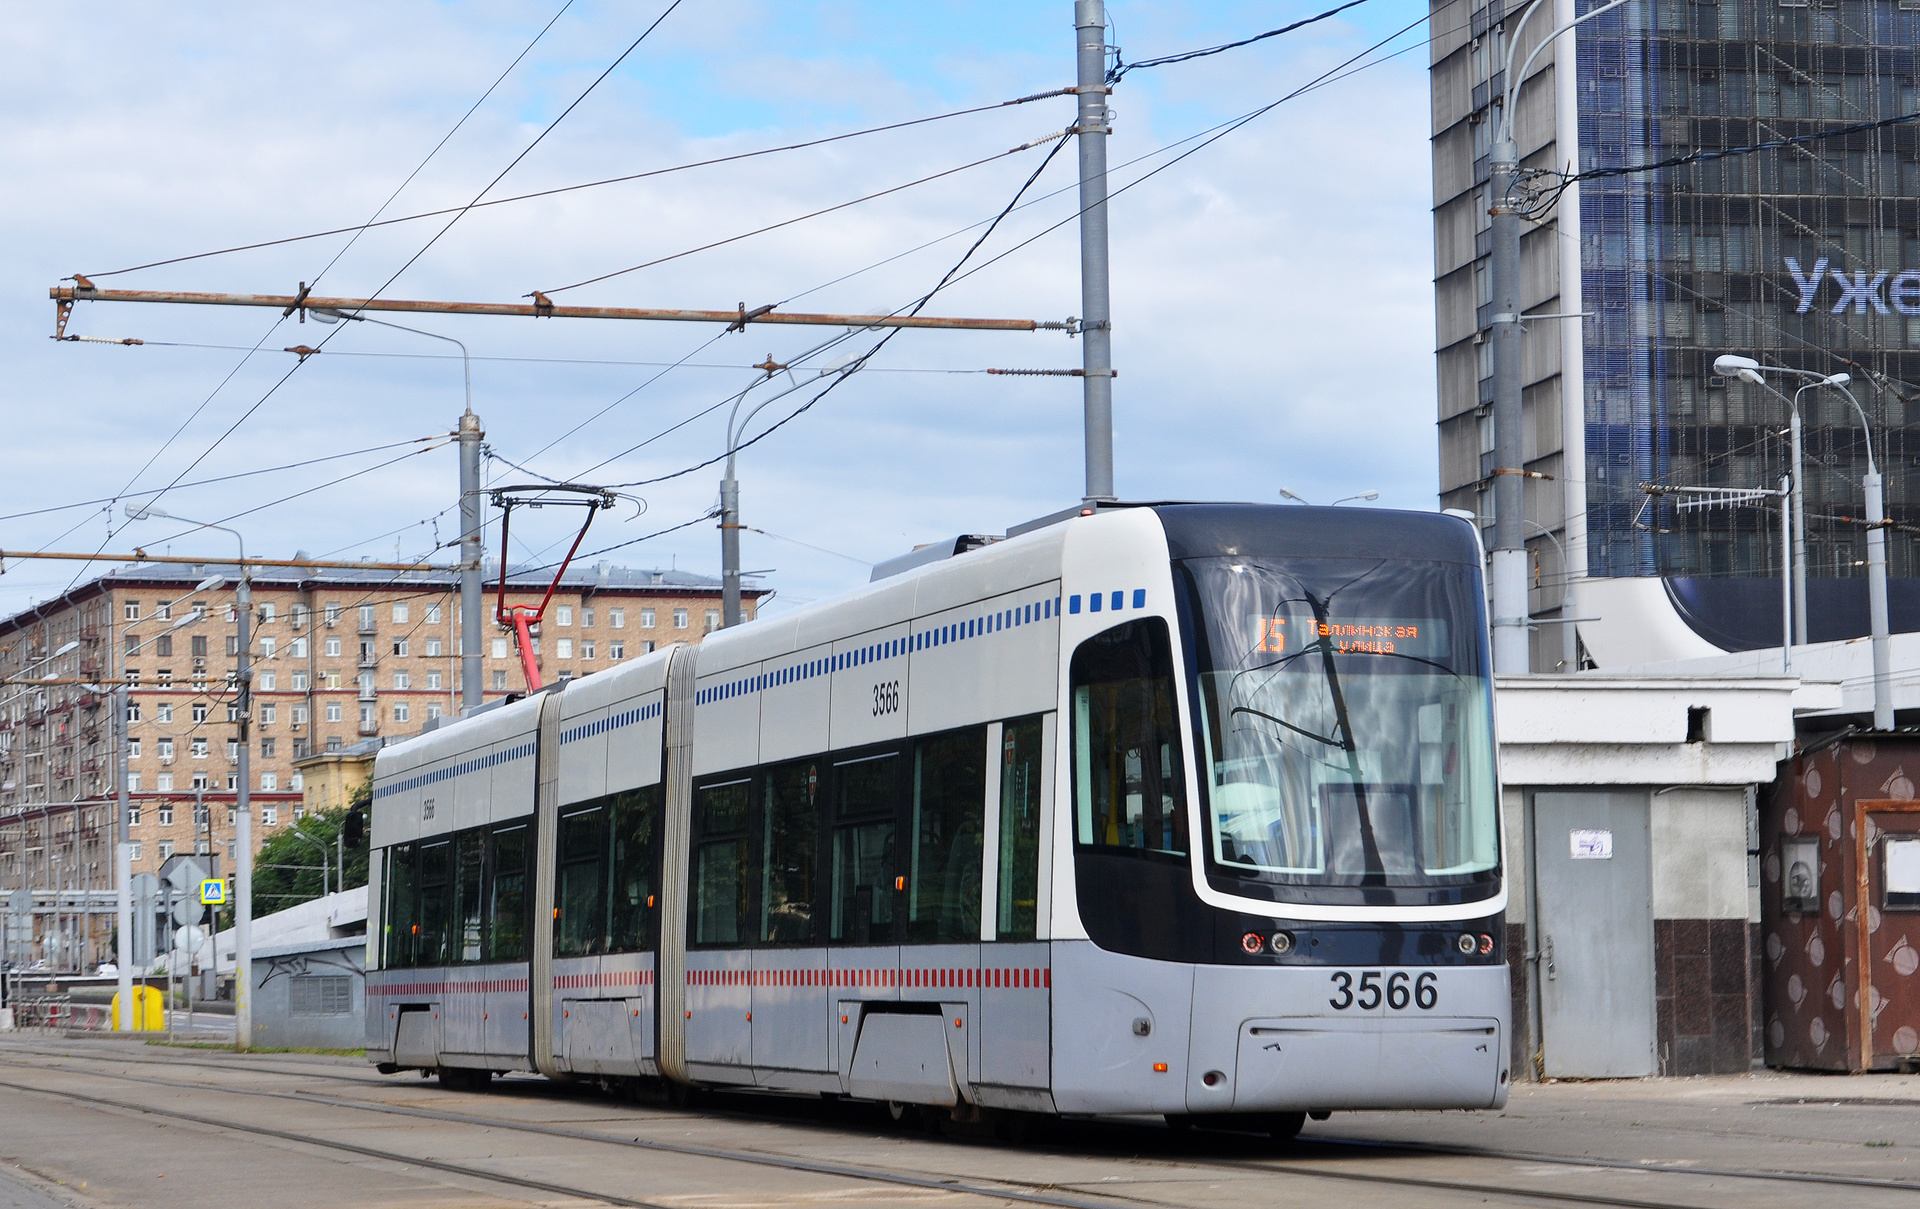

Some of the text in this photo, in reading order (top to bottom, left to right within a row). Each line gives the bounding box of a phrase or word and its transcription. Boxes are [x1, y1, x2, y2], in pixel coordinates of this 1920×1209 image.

[1783, 256, 1920, 316] Уже
[1258, 618, 1286, 652] 15
[1307, 619, 1418, 639] Таллинская
[1339, 639, 1395, 655] улица
[872, 679, 899, 717] 3566
[423, 797, 435, 821] 3566
[1328, 971, 1438, 1010] 3566
